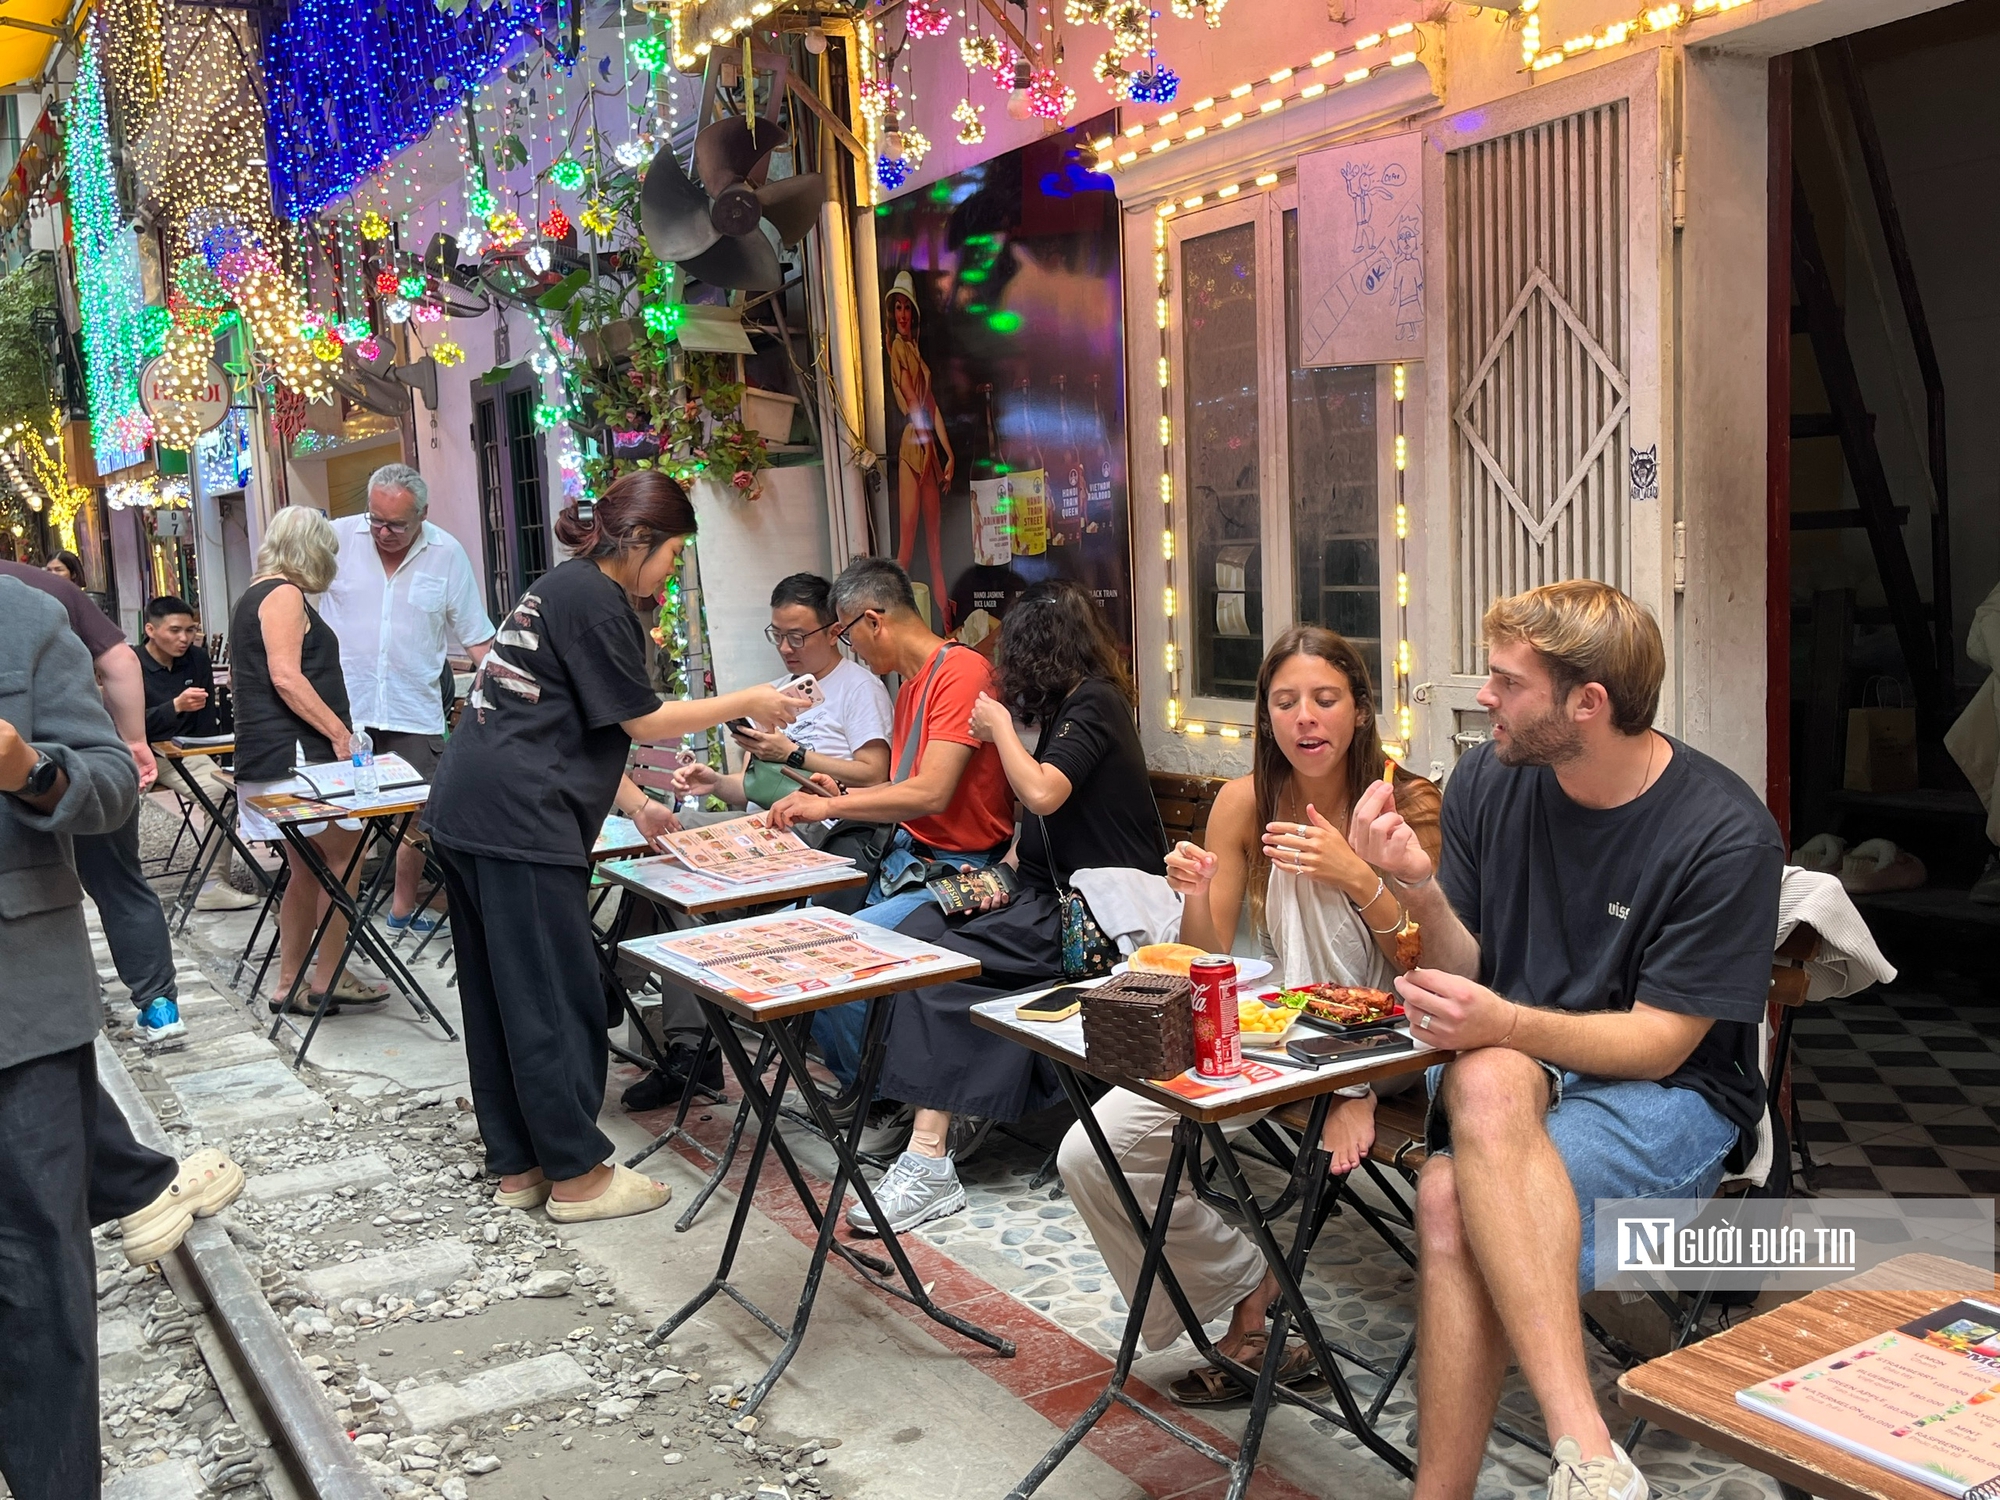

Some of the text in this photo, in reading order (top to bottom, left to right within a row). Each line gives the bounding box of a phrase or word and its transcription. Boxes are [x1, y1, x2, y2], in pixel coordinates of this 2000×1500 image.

[152, 382, 221, 402] HOI
[1023, 516, 1043, 526] STREET
[1061, 507, 1079, 519] QUEEN
[974, 600, 997, 608] RICE LAGER
[1103, 590, 1118, 598] TRAIN
[941, 879, 963, 907] MUSEUM
[1914, 1352, 1948, 1367] LEMON
[1875, 1356, 1969, 1397] STRAWBERRY 180.000
[1856, 1368, 1945, 1407] BLUEBERRY 180.000
[1802, 1386, 1895, 1429] WATERMELON 180.000
[1827, 1377, 1919, 1419] GREEN APPLE 180.000
[1954, 1424, 1983, 1437] MINT
[1914, 1431, 1970, 1453] RASPBERRY
